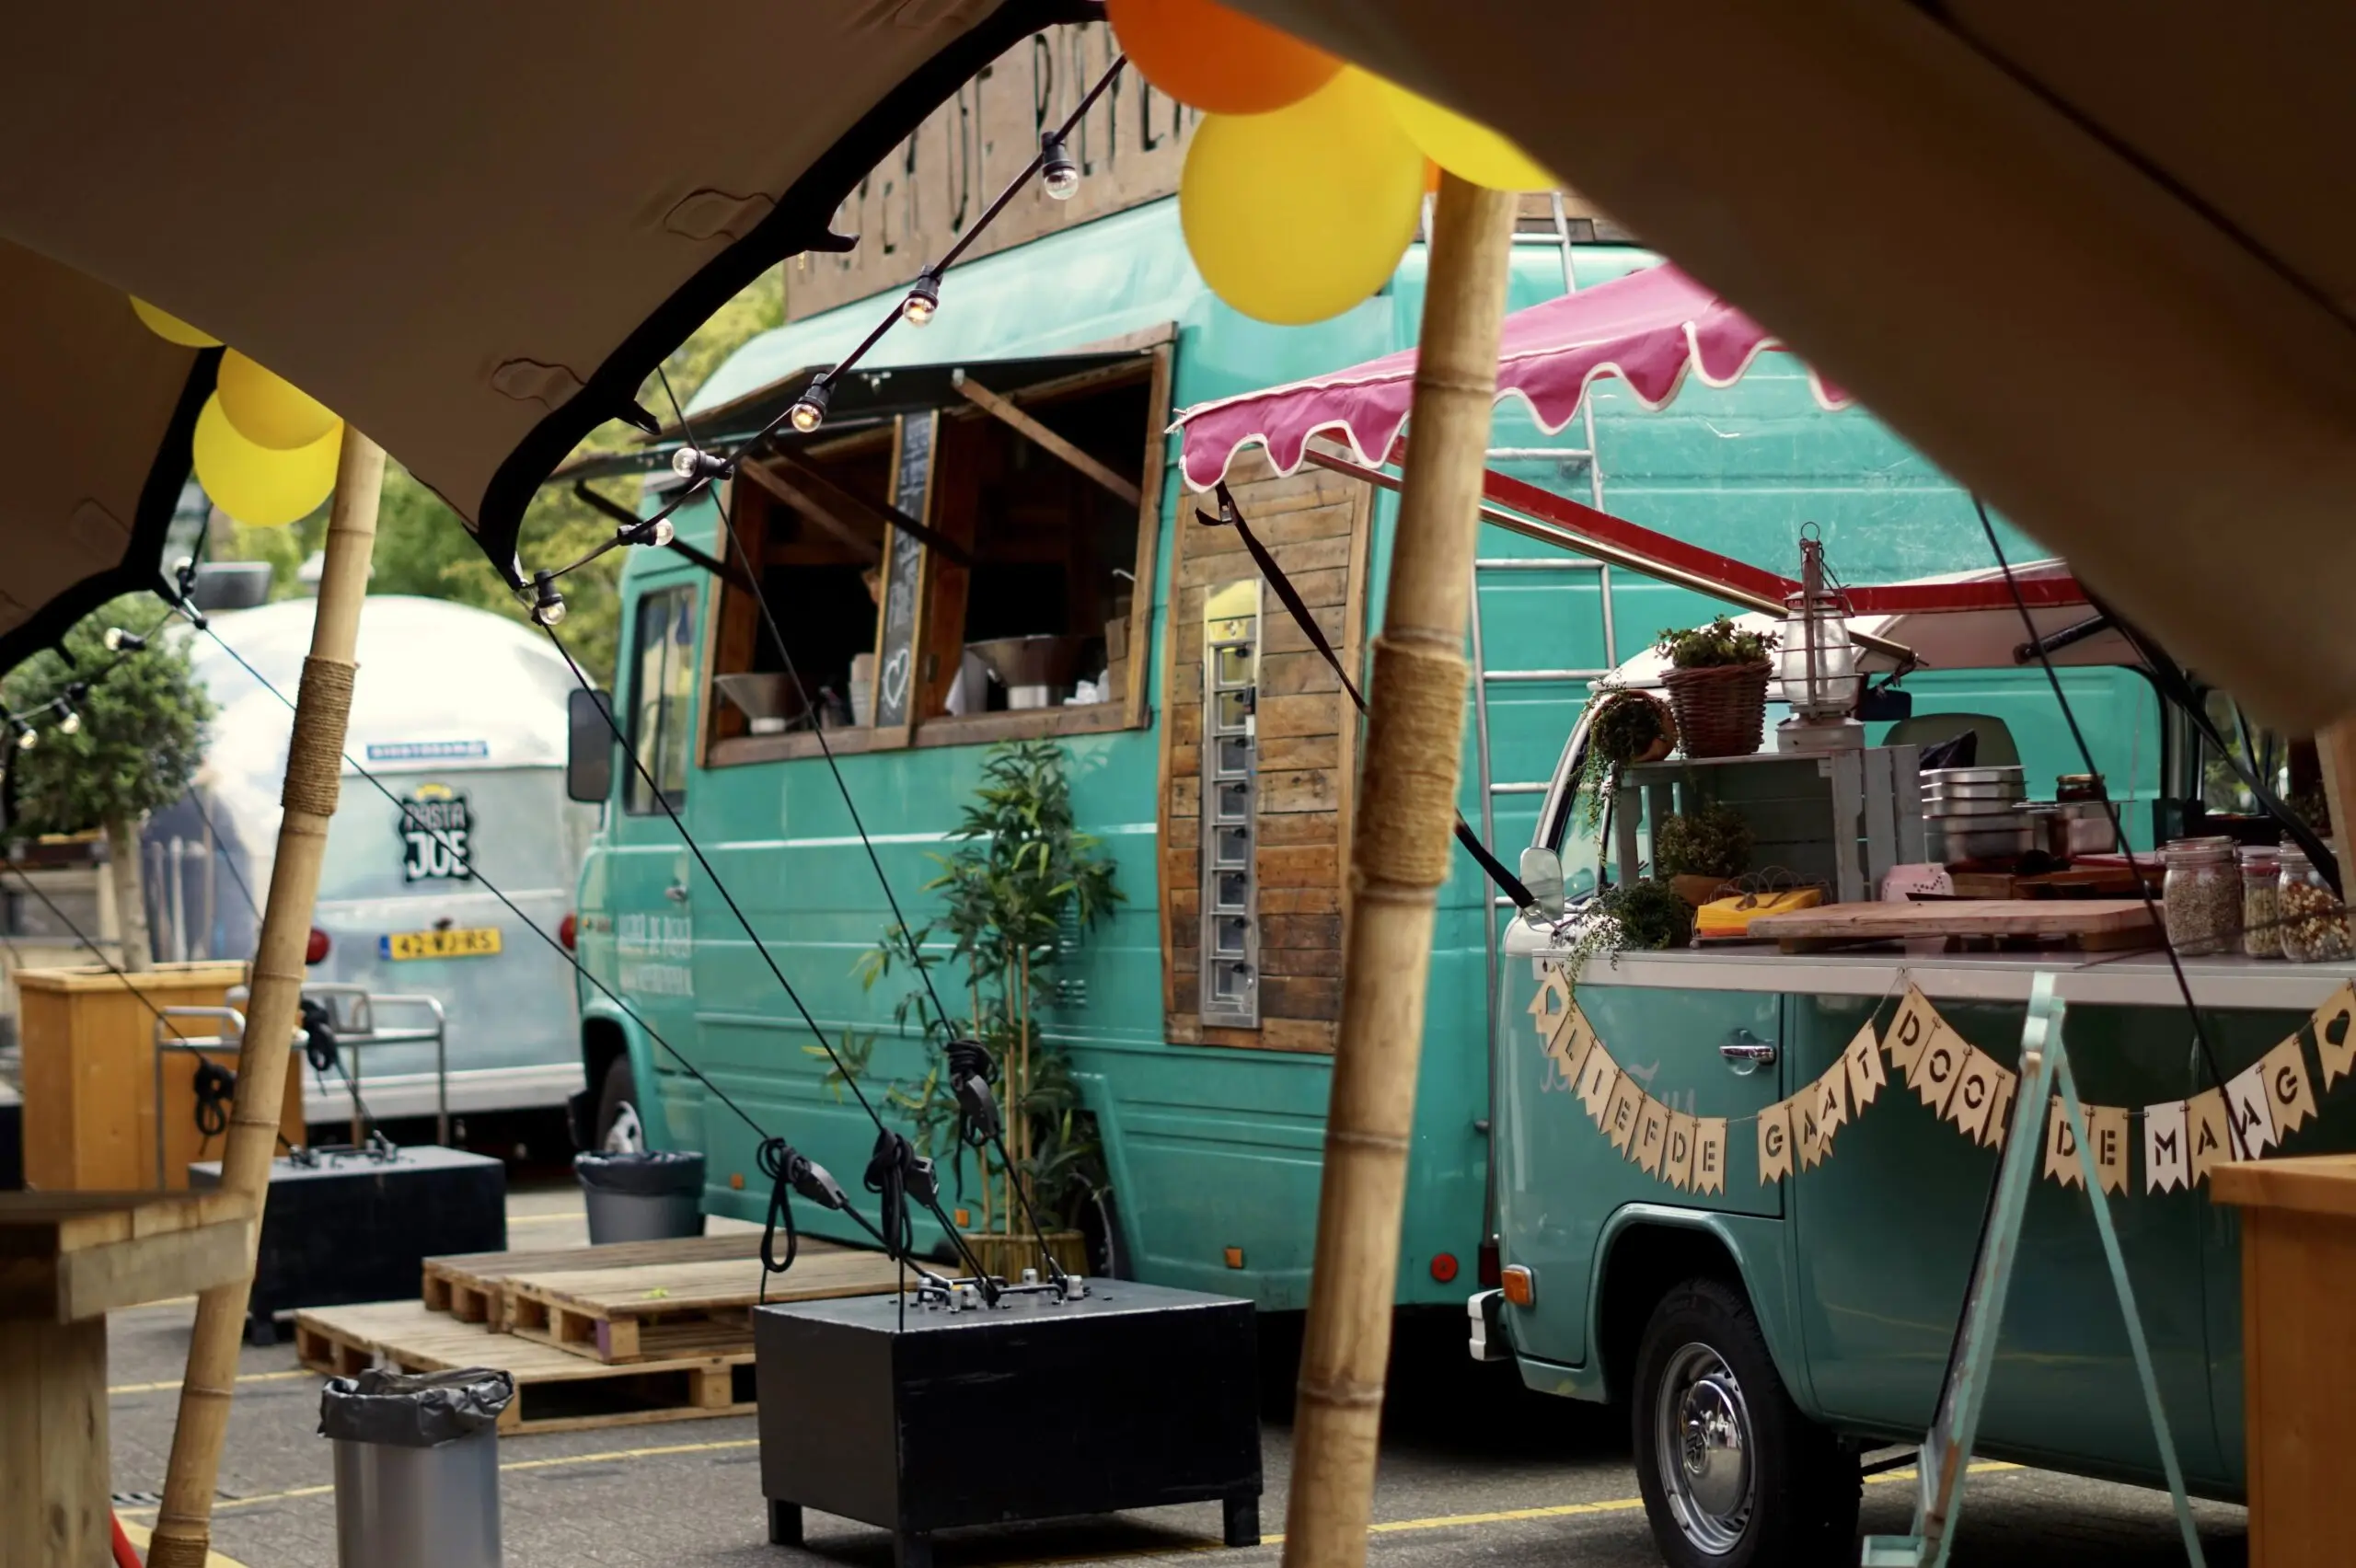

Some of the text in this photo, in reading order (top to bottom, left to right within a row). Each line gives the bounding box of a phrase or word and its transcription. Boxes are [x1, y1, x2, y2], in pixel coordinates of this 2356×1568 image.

[403, 802, 466, 831] PASTA
[406, 830, 468, 879] JOE
[1565, 1028, 1716, 1172] LIEFDE
[1764, 1046, 1874, 1159] GAAT
[2056, 1118, 2117, 1167] DE
[2154, 1065, 2299, 1168] MAAG
